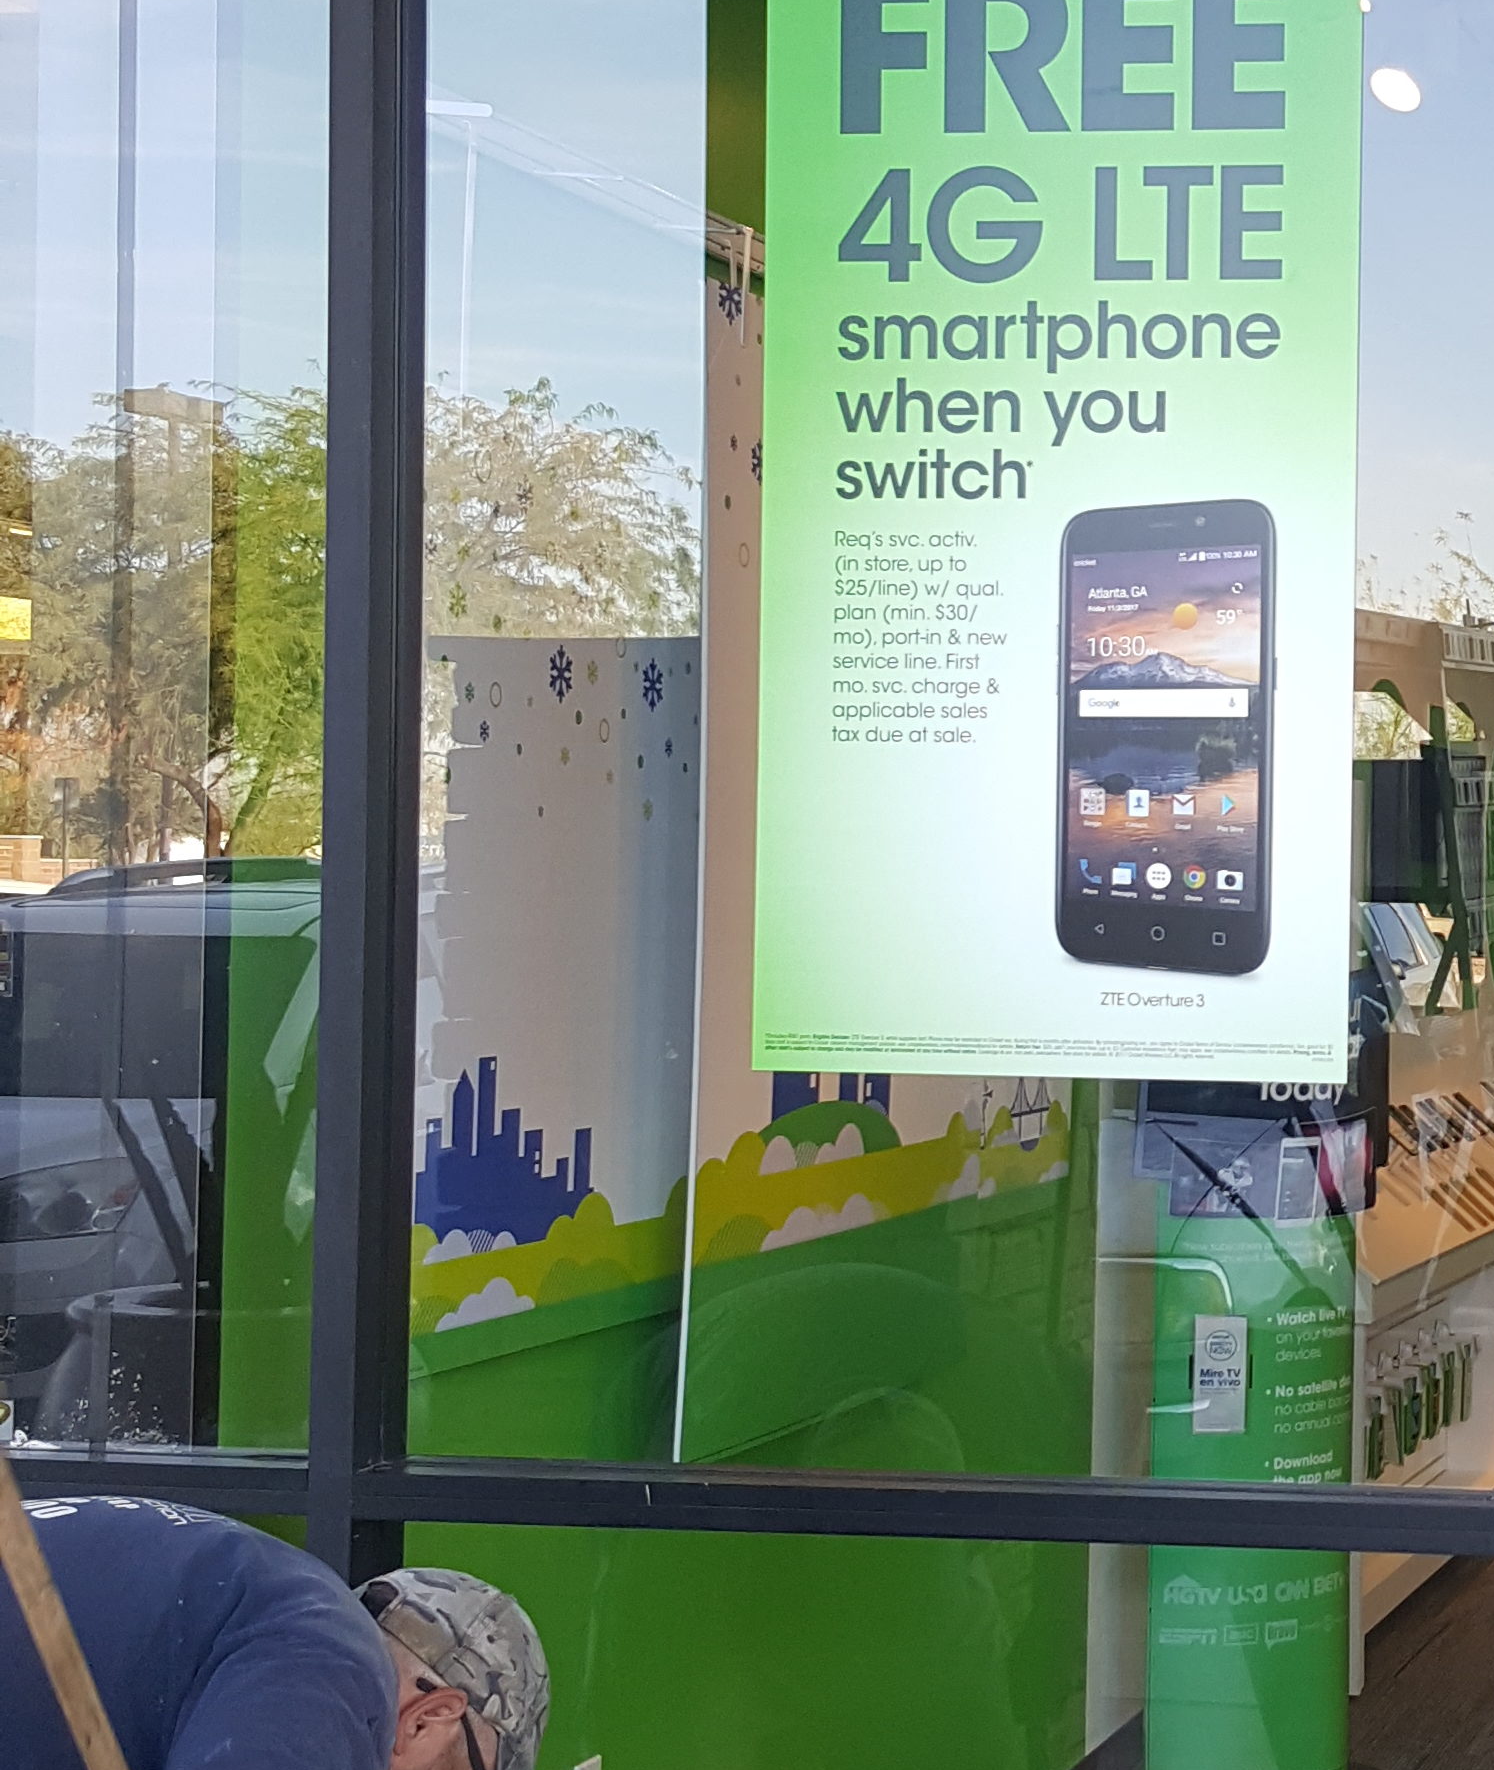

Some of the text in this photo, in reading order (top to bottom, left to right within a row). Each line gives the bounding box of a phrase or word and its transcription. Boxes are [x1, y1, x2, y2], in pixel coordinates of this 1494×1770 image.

[838, 164, 1284, 284] 4G LTE
[838, 300, 1281, 374] smartphone
[836, 377, 1167, 447] when you
[834, 530, 977, 550] Req's svc. activ.
[835, 555, 967, 575] (in store, up to
[834, 579, 1004, 600] $25/line) w/ qual.
[1088, 586, 1148, 600] Atlanta, GA
[834, 603, 978, 625] plan (min. $30/
[833, 629, 1007, 649] mo), port-in & new
[1087, 636, 1145, 657] 10:30
[833, 653, 980, 670] service line. First
[833, 678, 1000, 699] mo. svc. charge &
[832, 702, 988, 721] applicable sales
[832, 726, 976, 743] tax due at sale.
[1100, 992, 1206, 1007] ZTE Overture 3
[1276, 1311, 1316, 1325] Watch
[1319, 1309, 1335, 1322] live
[1218, 1379, 1241, 1387] vivo
[1227, 1369, 1241, 1378] TV
[1275, 1386, 1294, 1398] No
[1274, 1404, 1292, 1416] no
[1274, 1423, 1291, 1433] no
[1273, 1450, 1333, 1470] Download
[1163, 1587, 1222, 1605] HGTV
